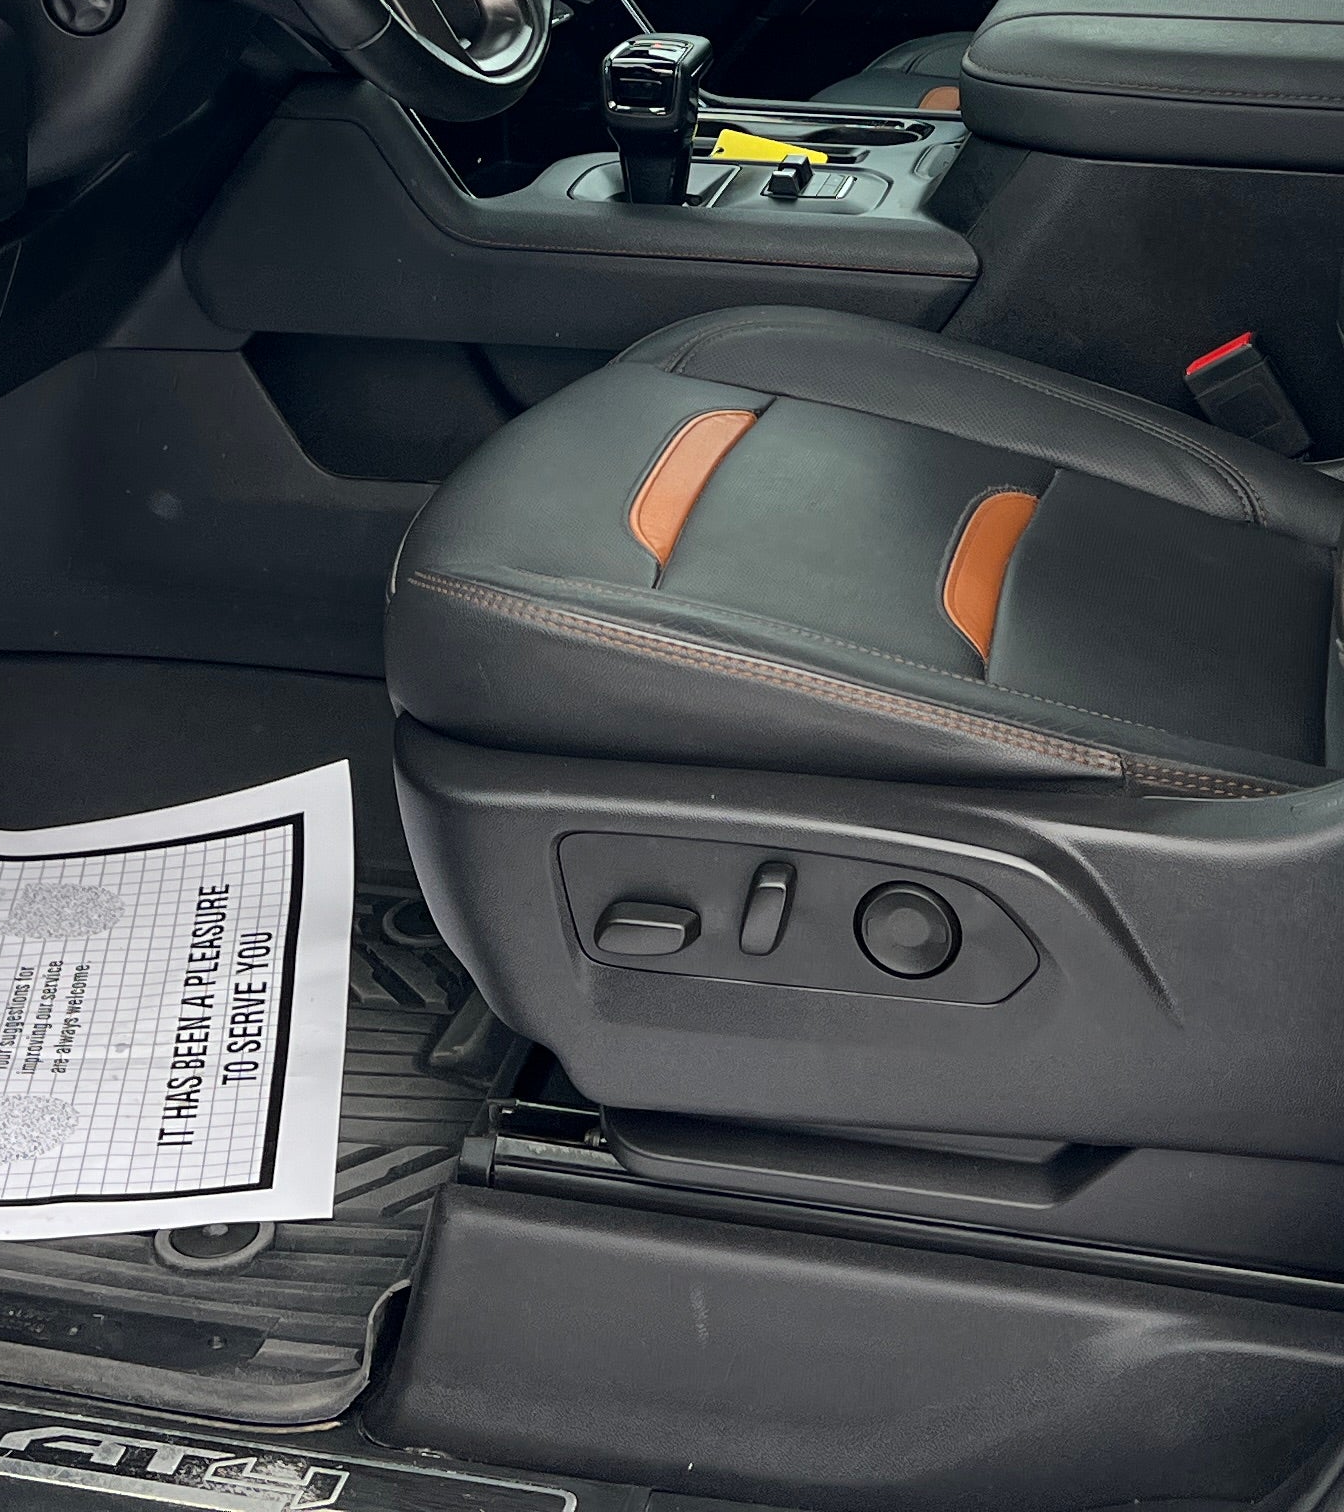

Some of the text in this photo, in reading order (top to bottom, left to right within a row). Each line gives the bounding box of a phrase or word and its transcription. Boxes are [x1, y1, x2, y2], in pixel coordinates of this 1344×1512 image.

[14, 966, 35, 981] for
[0, 984, 30, 1047] suggestions
[16, 960, 63, 1075] improving our service
[53, 1017, 82, 1054] always
[157, 883, 230, 1147] IT HAS BEEN A PLEASURE
[221, 931, 273, 1085] TO SERVE YOU
[51, 1058, 69, 1074] are
